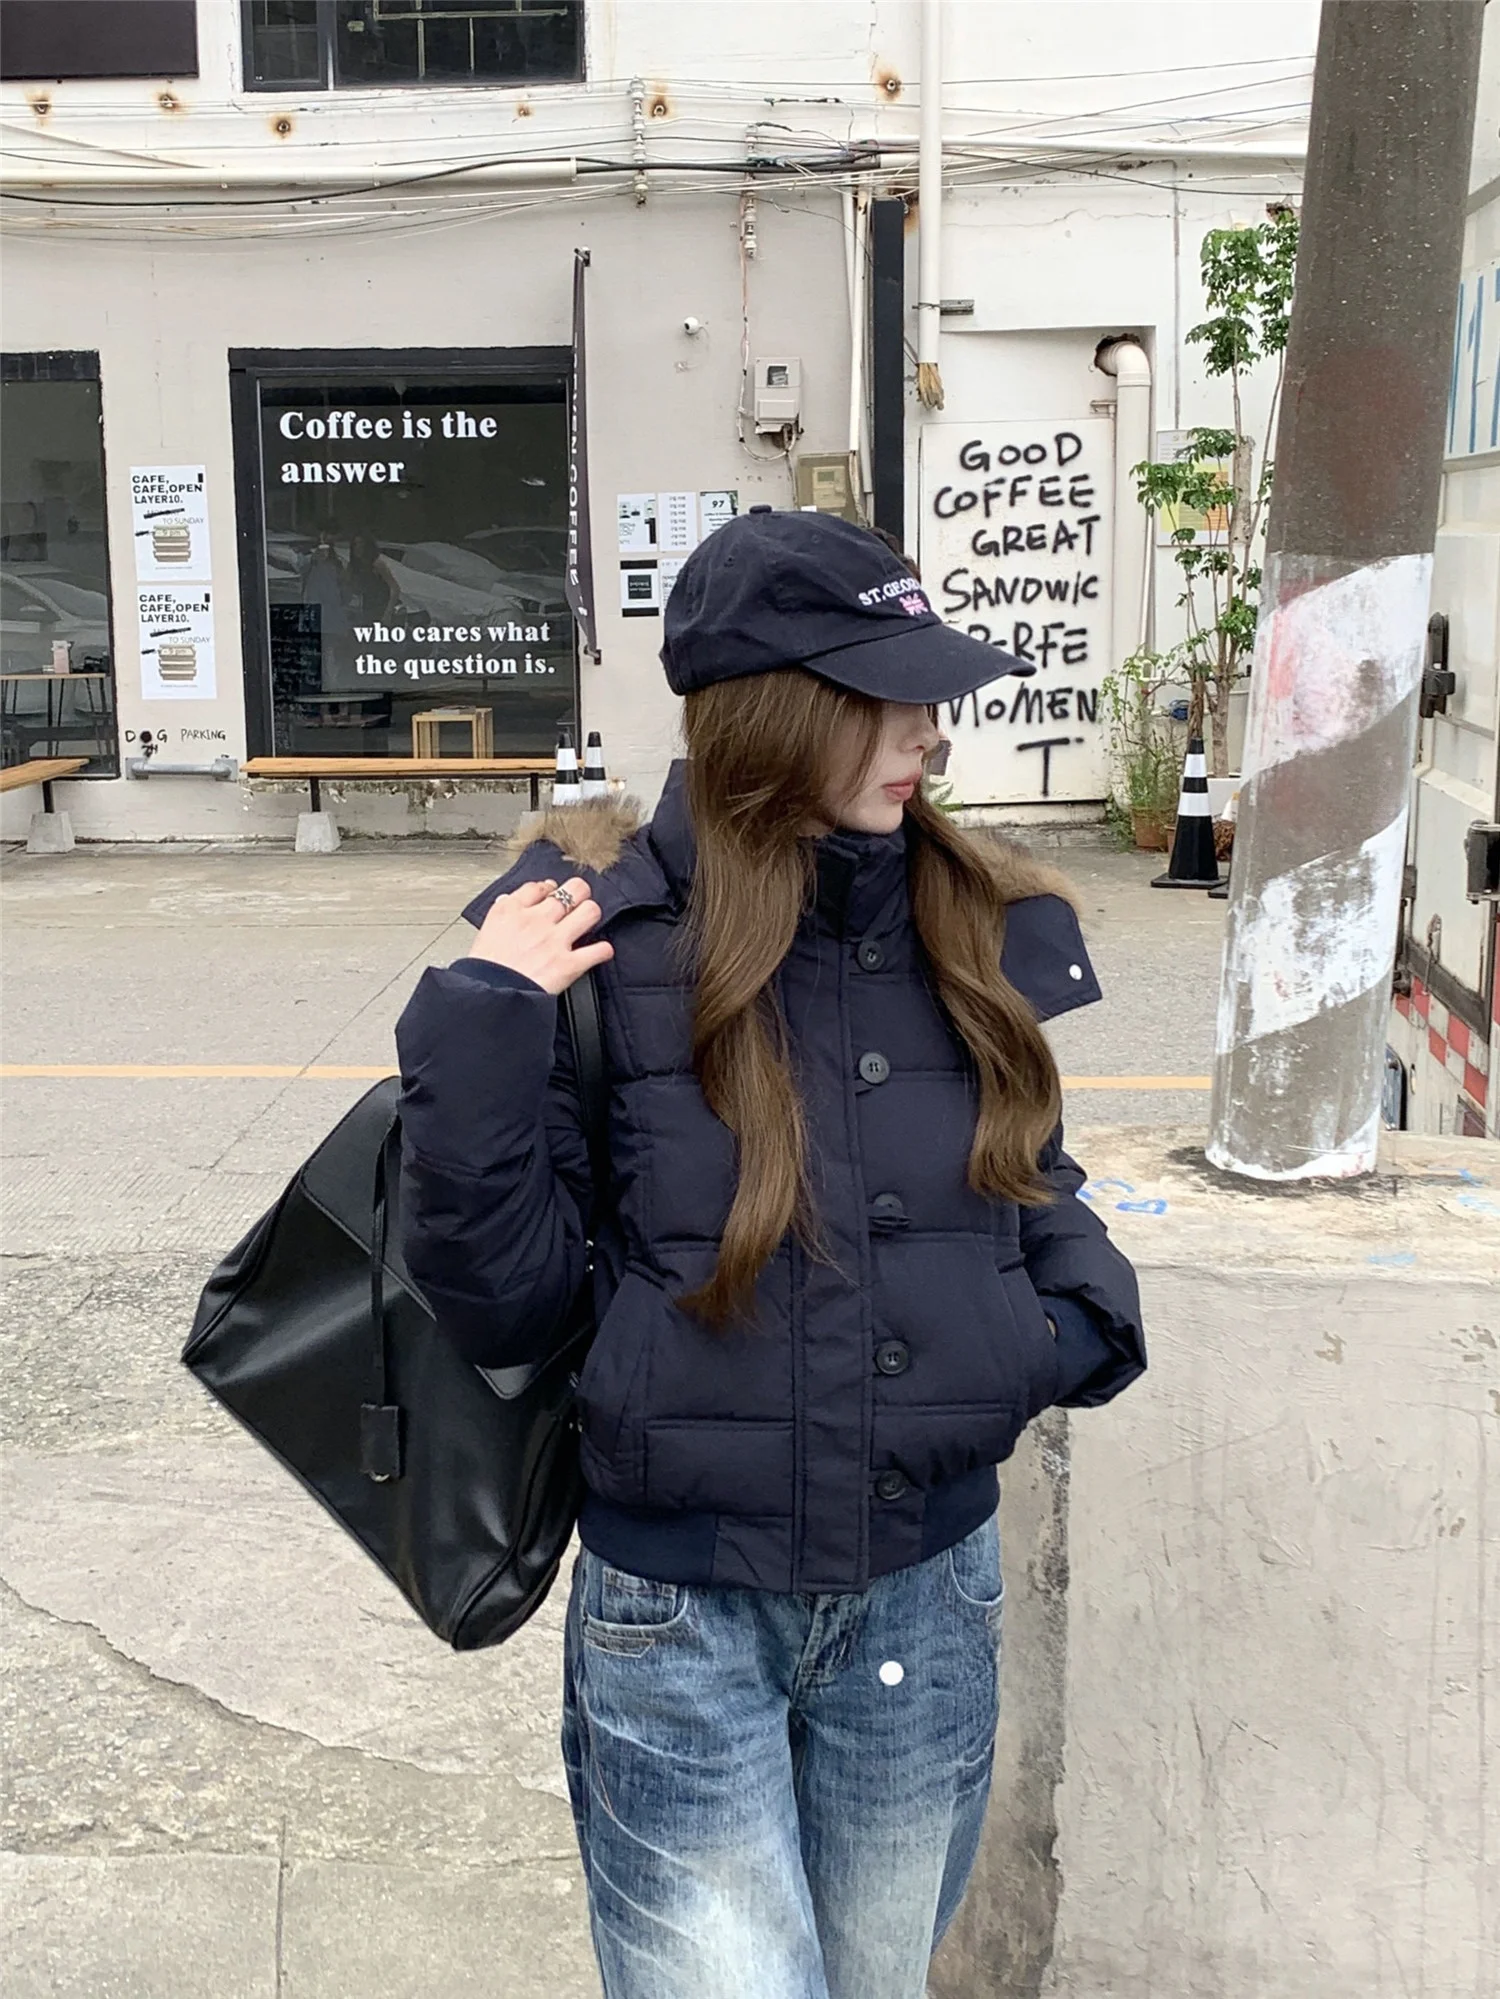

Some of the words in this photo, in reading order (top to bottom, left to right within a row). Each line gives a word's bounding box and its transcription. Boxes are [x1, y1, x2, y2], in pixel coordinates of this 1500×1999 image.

[279, 410, 393, 440] Coffee
[402, 410, 432, 438] is
[441, 411, 497, 438] the
[959, 431, 1083, 473] GOOD
[281, 460, 404, 483] answer
[934, 474, 1095, 519] COFFEE
[174, 516, 205, 525] SUNDAY
[971, 514, 1101, 558] GREAT
[942, 568, 1098, 613] SANDWIC
[180, 636, 210, 644] SUNDAY
[353, 622, 406, 642] who
[412, 625, 482, 642] cares
[487, 621, 551, 642] what
[355, 654, 397, 675] the
[403, 653, 518, 680] question
[524, 653, 556, 674] is.
[180, 728, 226, 741] PARKING
